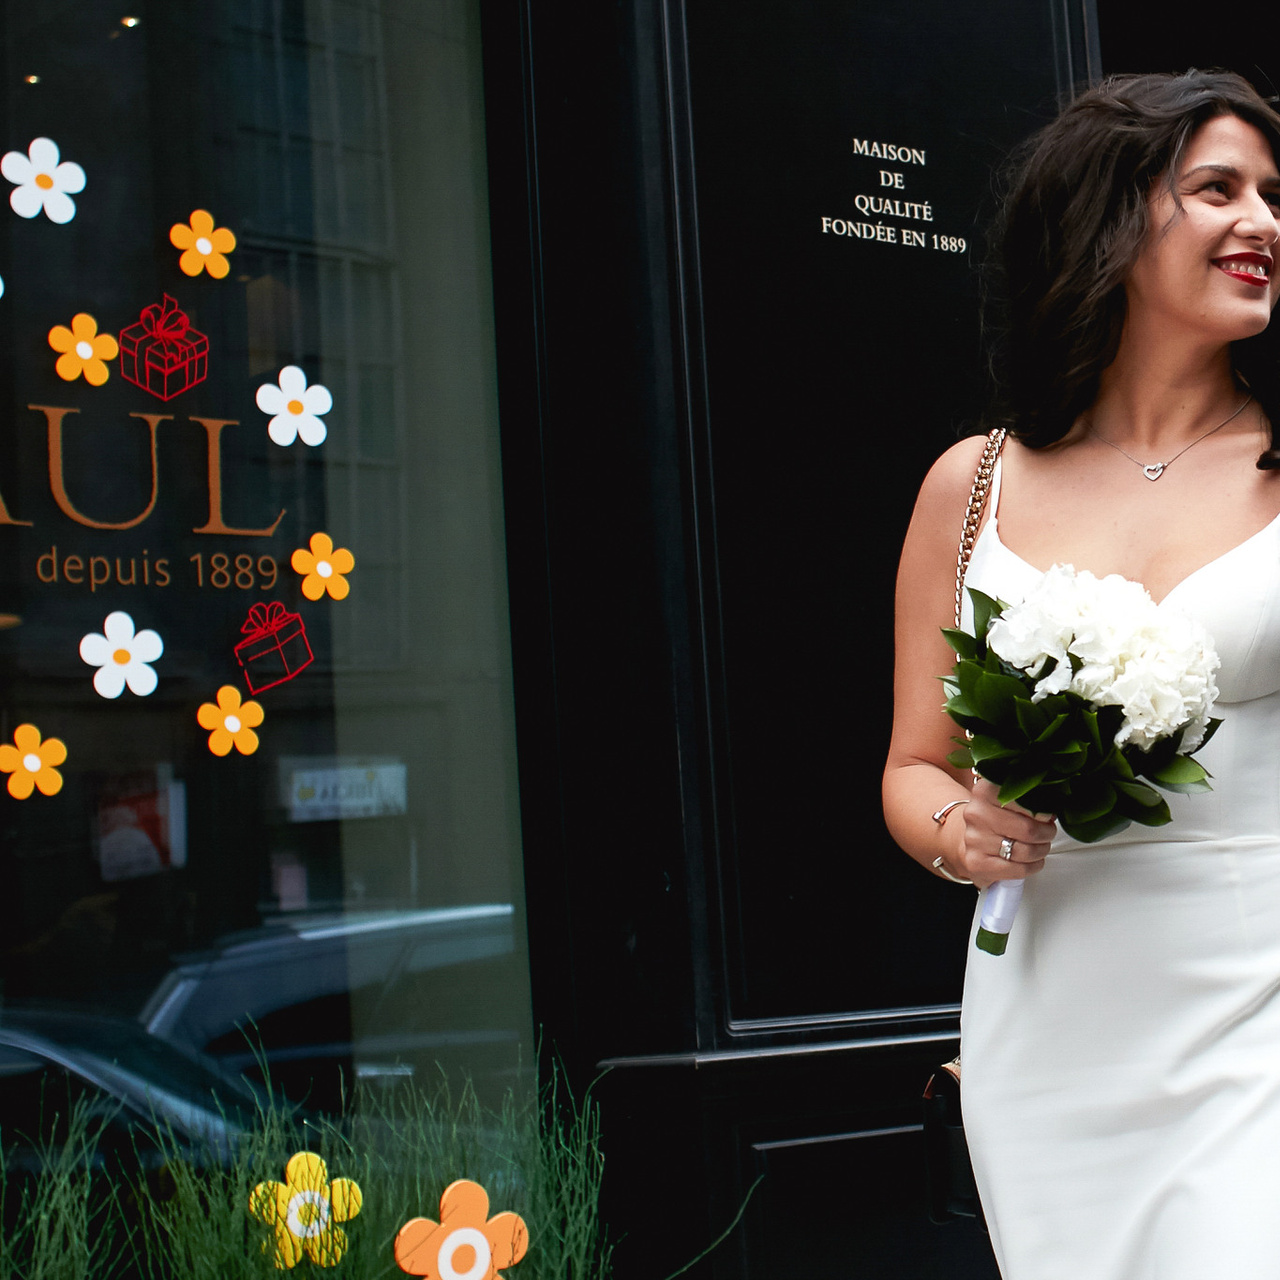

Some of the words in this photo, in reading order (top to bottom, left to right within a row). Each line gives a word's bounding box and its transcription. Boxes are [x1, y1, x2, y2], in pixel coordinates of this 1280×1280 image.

[852, 138, 926, 166] MAISON
[878, 170, 905, 190] DE
[854, 194, 933, 222] QUALITÉ
[821, 217, 897, 244] FONDÉE
[901, 228, 926, 248] EN
[932, 234, 967, 253] 1889
[36, 545, 171, 593] depuis
[190, 553, 278, 590] 1889
